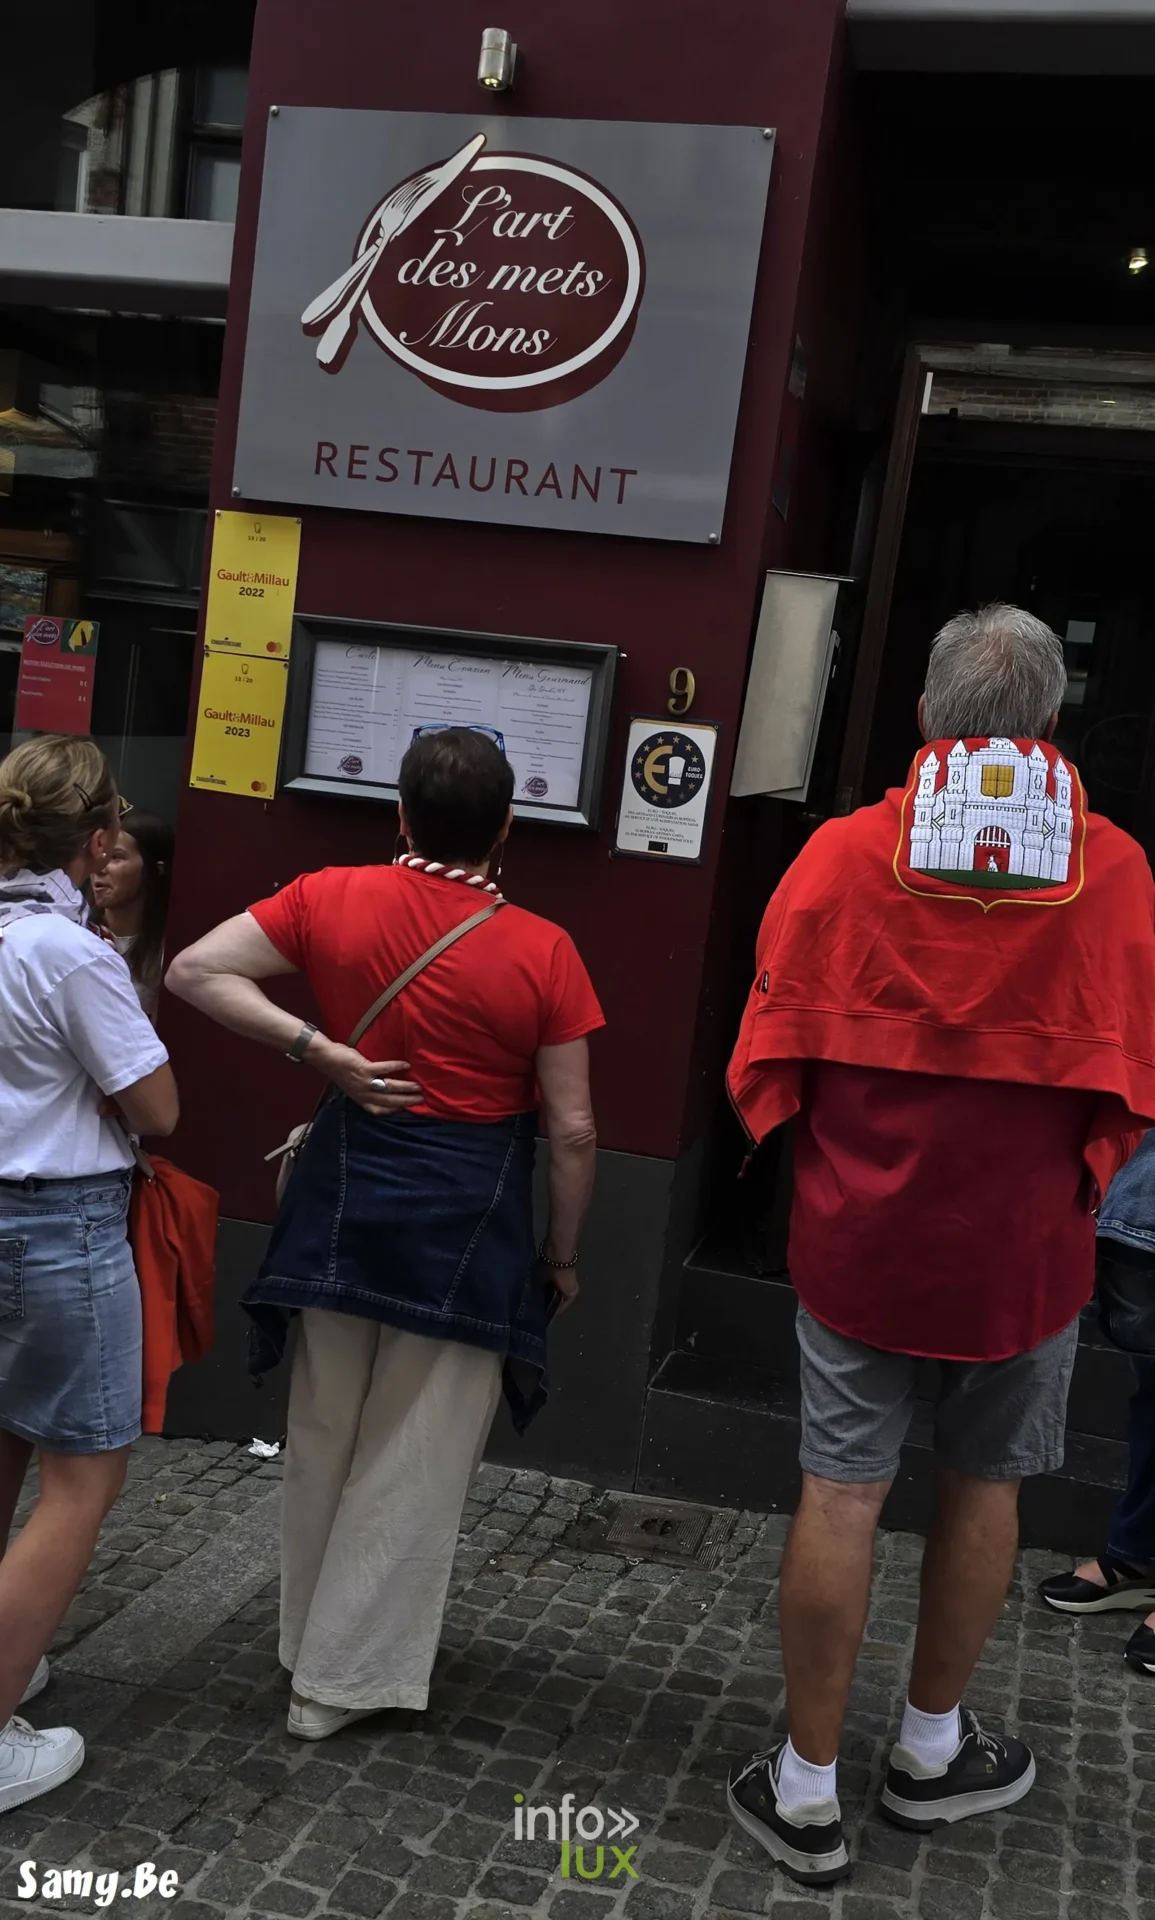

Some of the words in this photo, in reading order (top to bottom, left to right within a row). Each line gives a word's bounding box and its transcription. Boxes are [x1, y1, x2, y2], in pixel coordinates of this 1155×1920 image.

[434, 185, 576, 245] L'art
[397, 237, 485, 289] des
[486, 260, 612, 297] mets
[399, 299, 559, 355] Mons
[314, 441, 638, 505] RESTAURANT
[217, 569, 290, 587] Gault&Millau
[239, 587, 265, 598] 2022
[414, 655, 445, 670] Menu
[502, 664, 534, 679] Menu
[537, 668, 591, 685] Gourmand
[668, 667, 696, 715] 9
[204, 707, 275, 728] Gault&Millau
[225, 726, 251, 738] 2023
